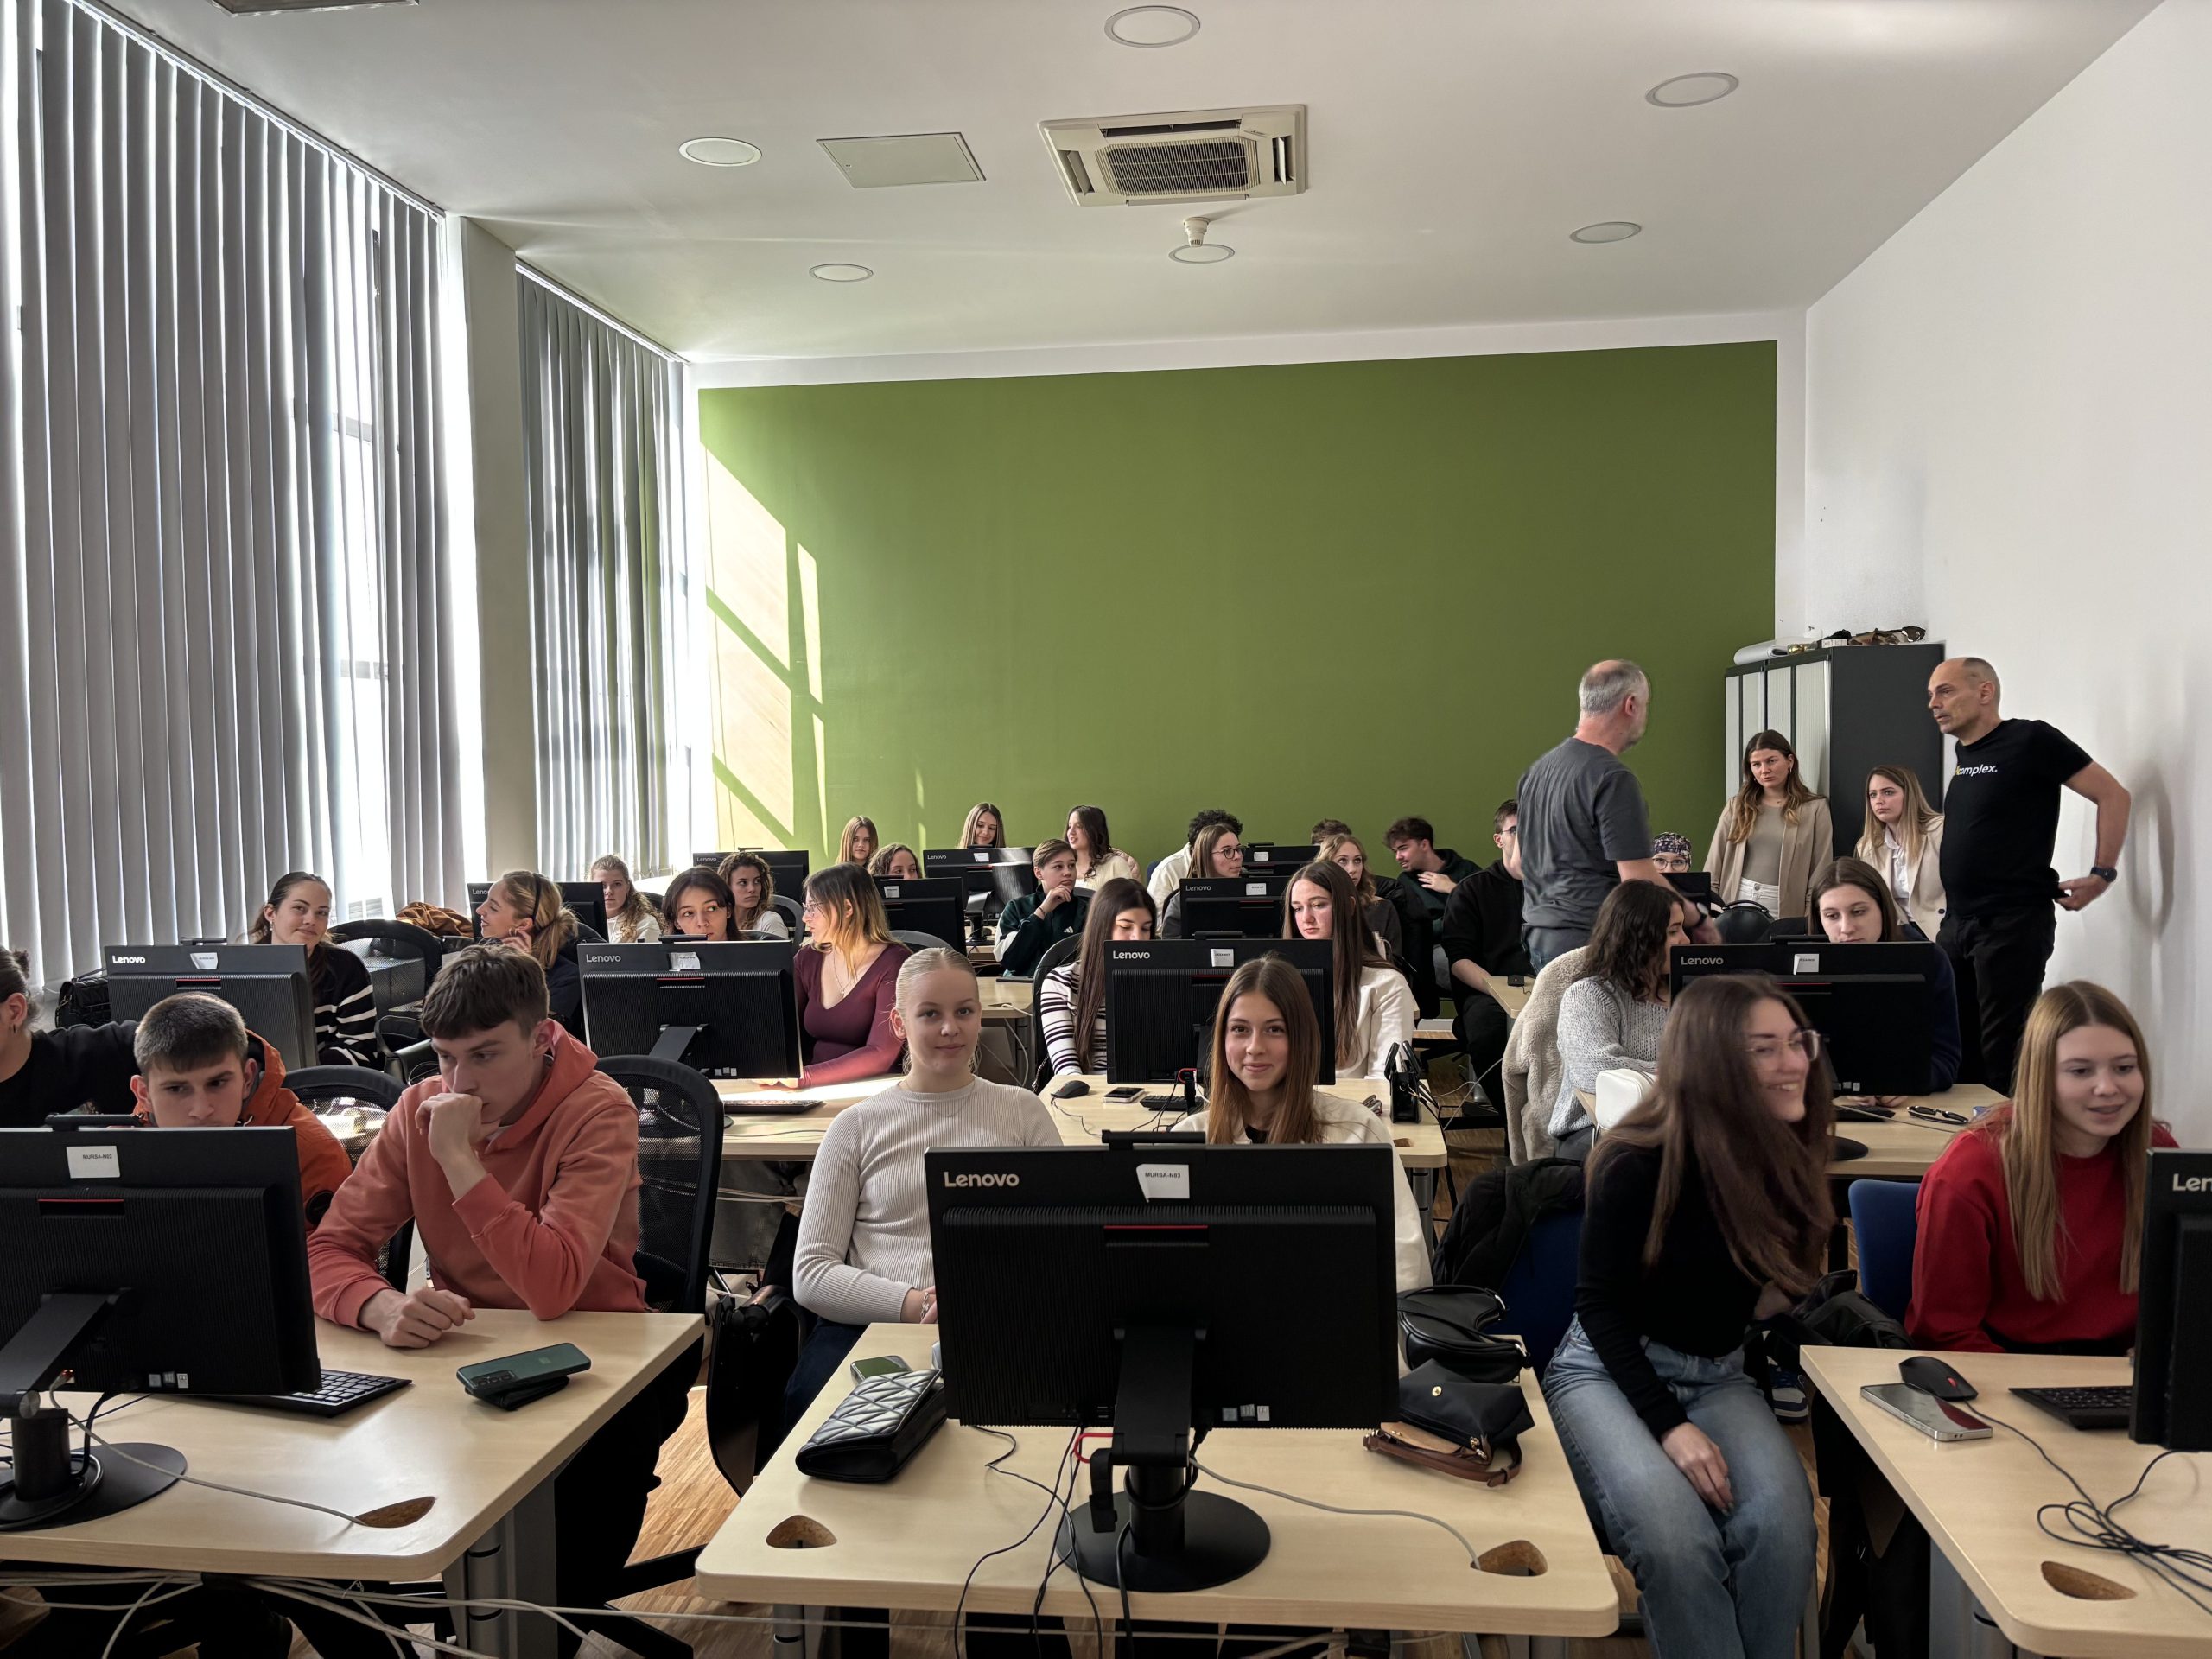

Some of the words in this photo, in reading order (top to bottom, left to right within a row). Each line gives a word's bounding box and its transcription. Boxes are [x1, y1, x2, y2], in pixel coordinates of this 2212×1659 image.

[111, 955, 146, 964] Lenovo
[586, 953, 621, 963] Lenovo
[1112, 950, 1151, 960] Lenovo
[1681, 956, 1724, 965] Lenovo
[944, 1171, 1020, 1187] Lenovo
